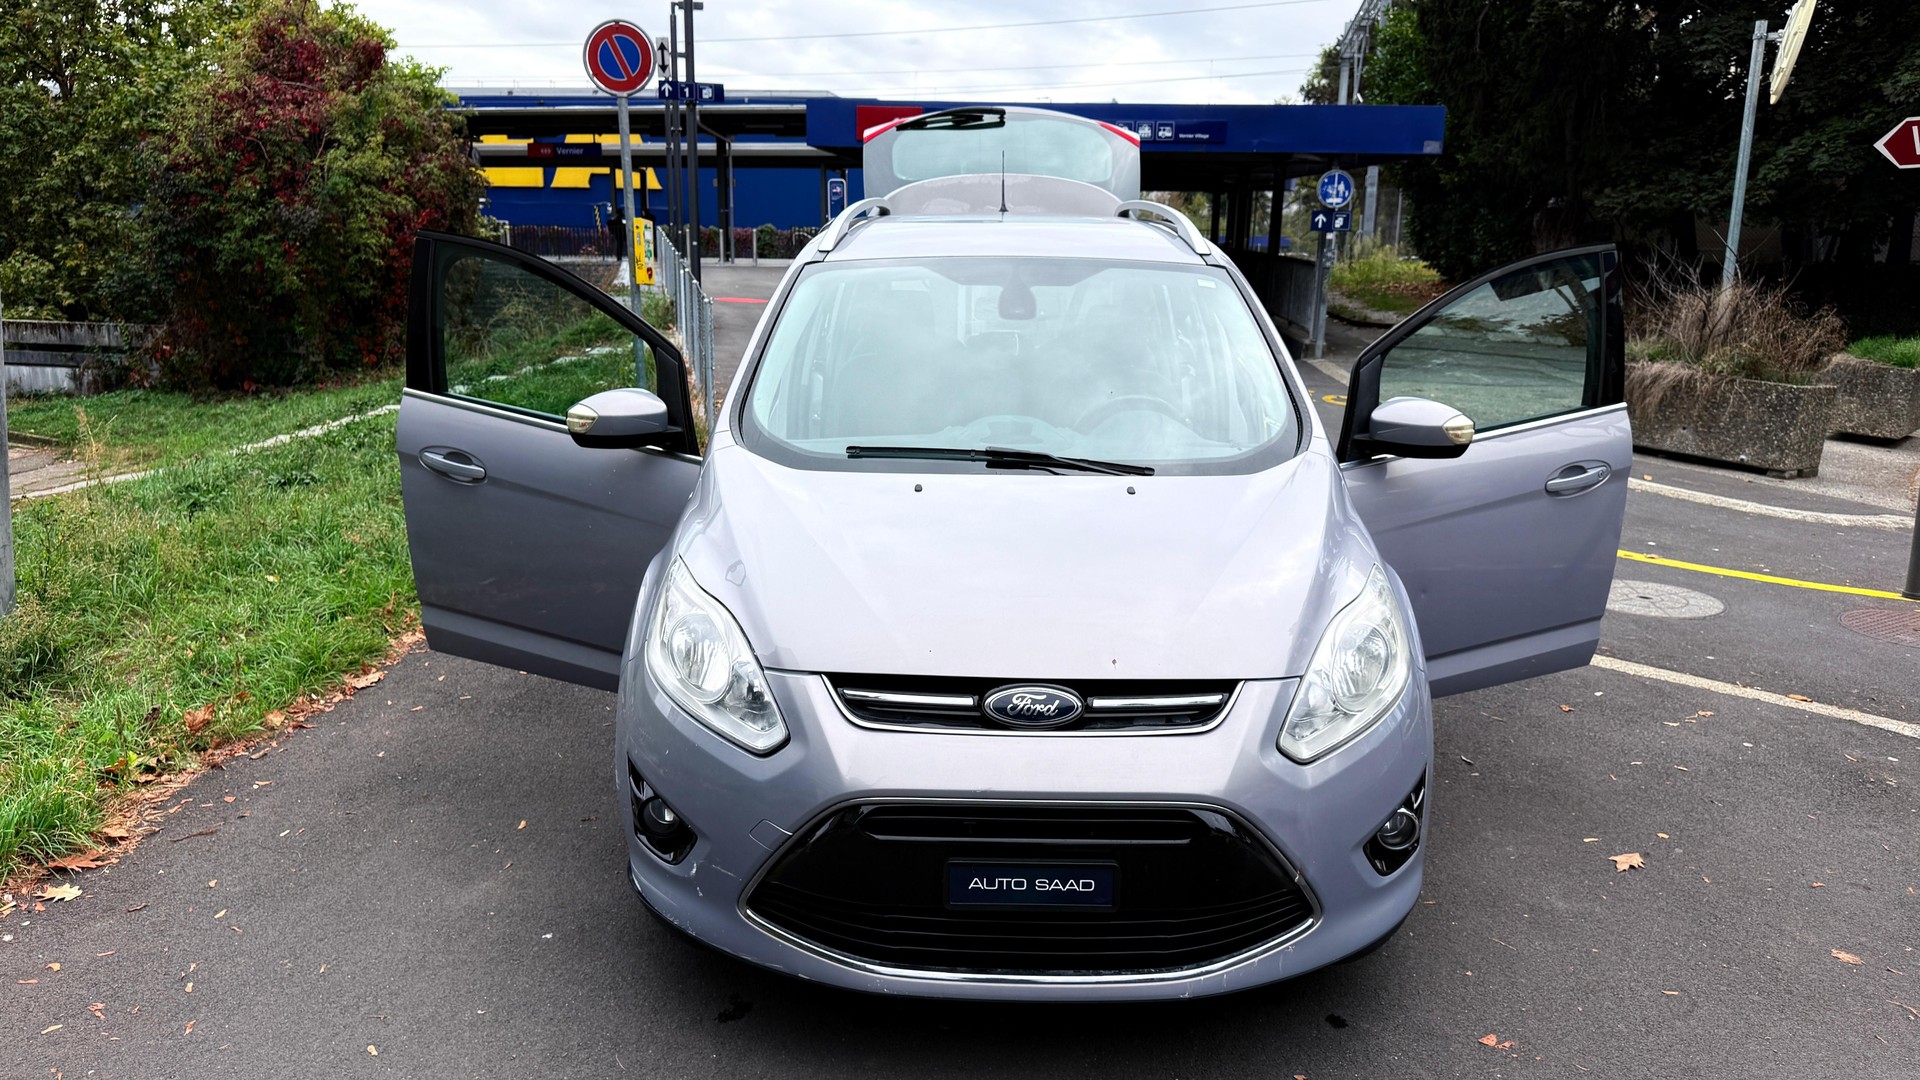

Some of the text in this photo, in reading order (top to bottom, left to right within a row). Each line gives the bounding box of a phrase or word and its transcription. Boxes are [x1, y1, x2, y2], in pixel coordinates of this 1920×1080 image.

[683, 87, 690, 98] 1
[556, 147, 584, 155] Vernier
[1006, 693, 1060, 716] Ford
[968, 877, 1095, 892] AUTO SAAD
